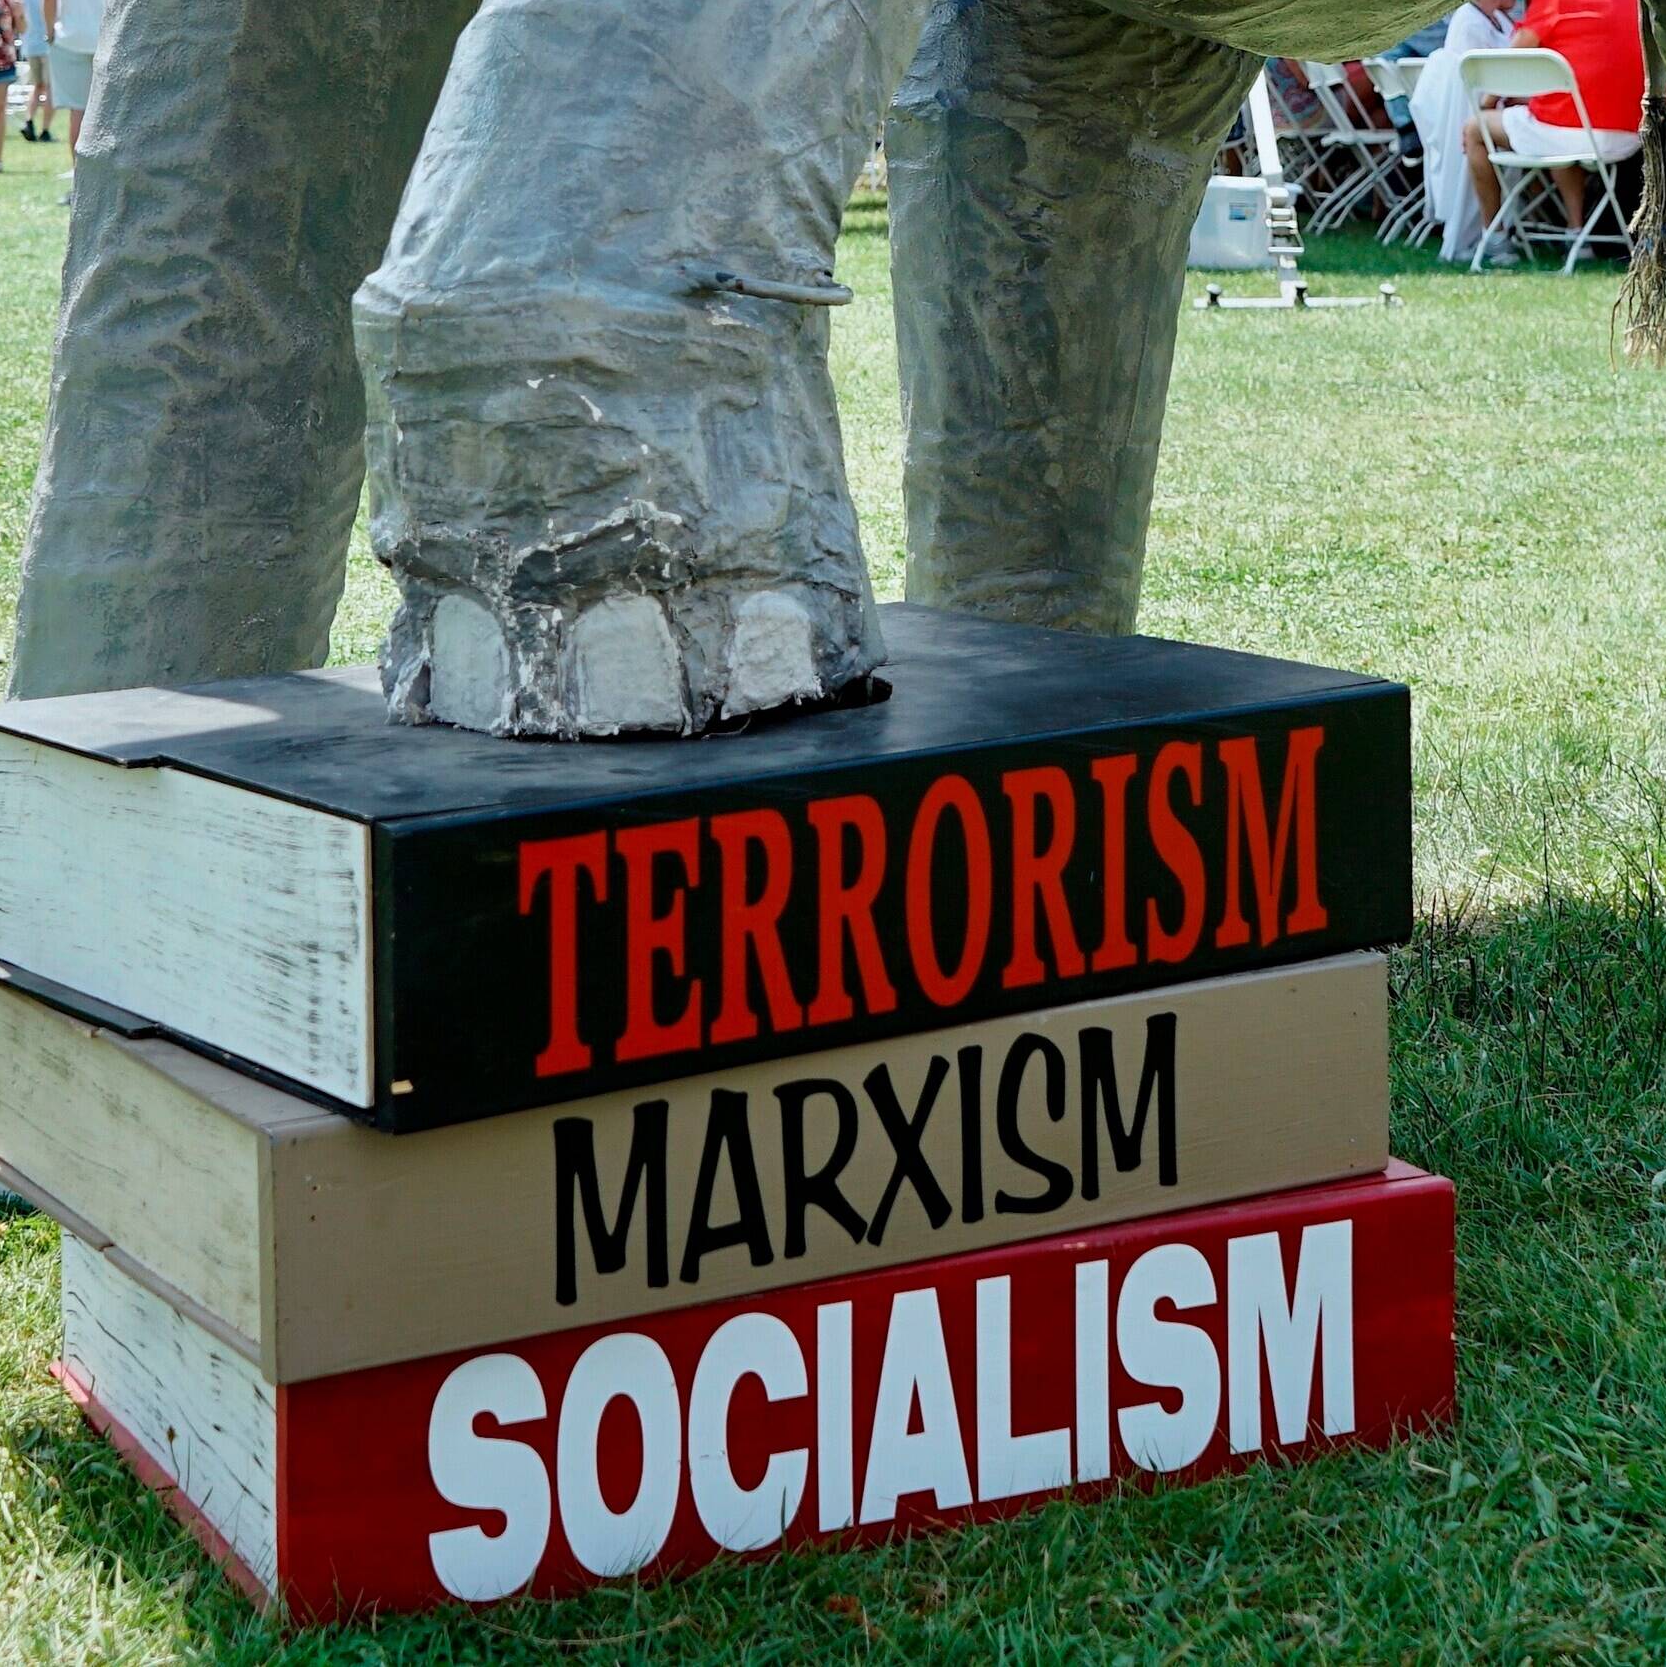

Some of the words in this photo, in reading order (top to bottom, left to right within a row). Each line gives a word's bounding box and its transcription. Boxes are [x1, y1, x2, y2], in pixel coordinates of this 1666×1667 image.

[520, 727, 1327, 1075] TERRORISM
[551, 1011, 1179, 1308] MARXISM
[428, 1218, 1355, 1601] SOCIALISM
